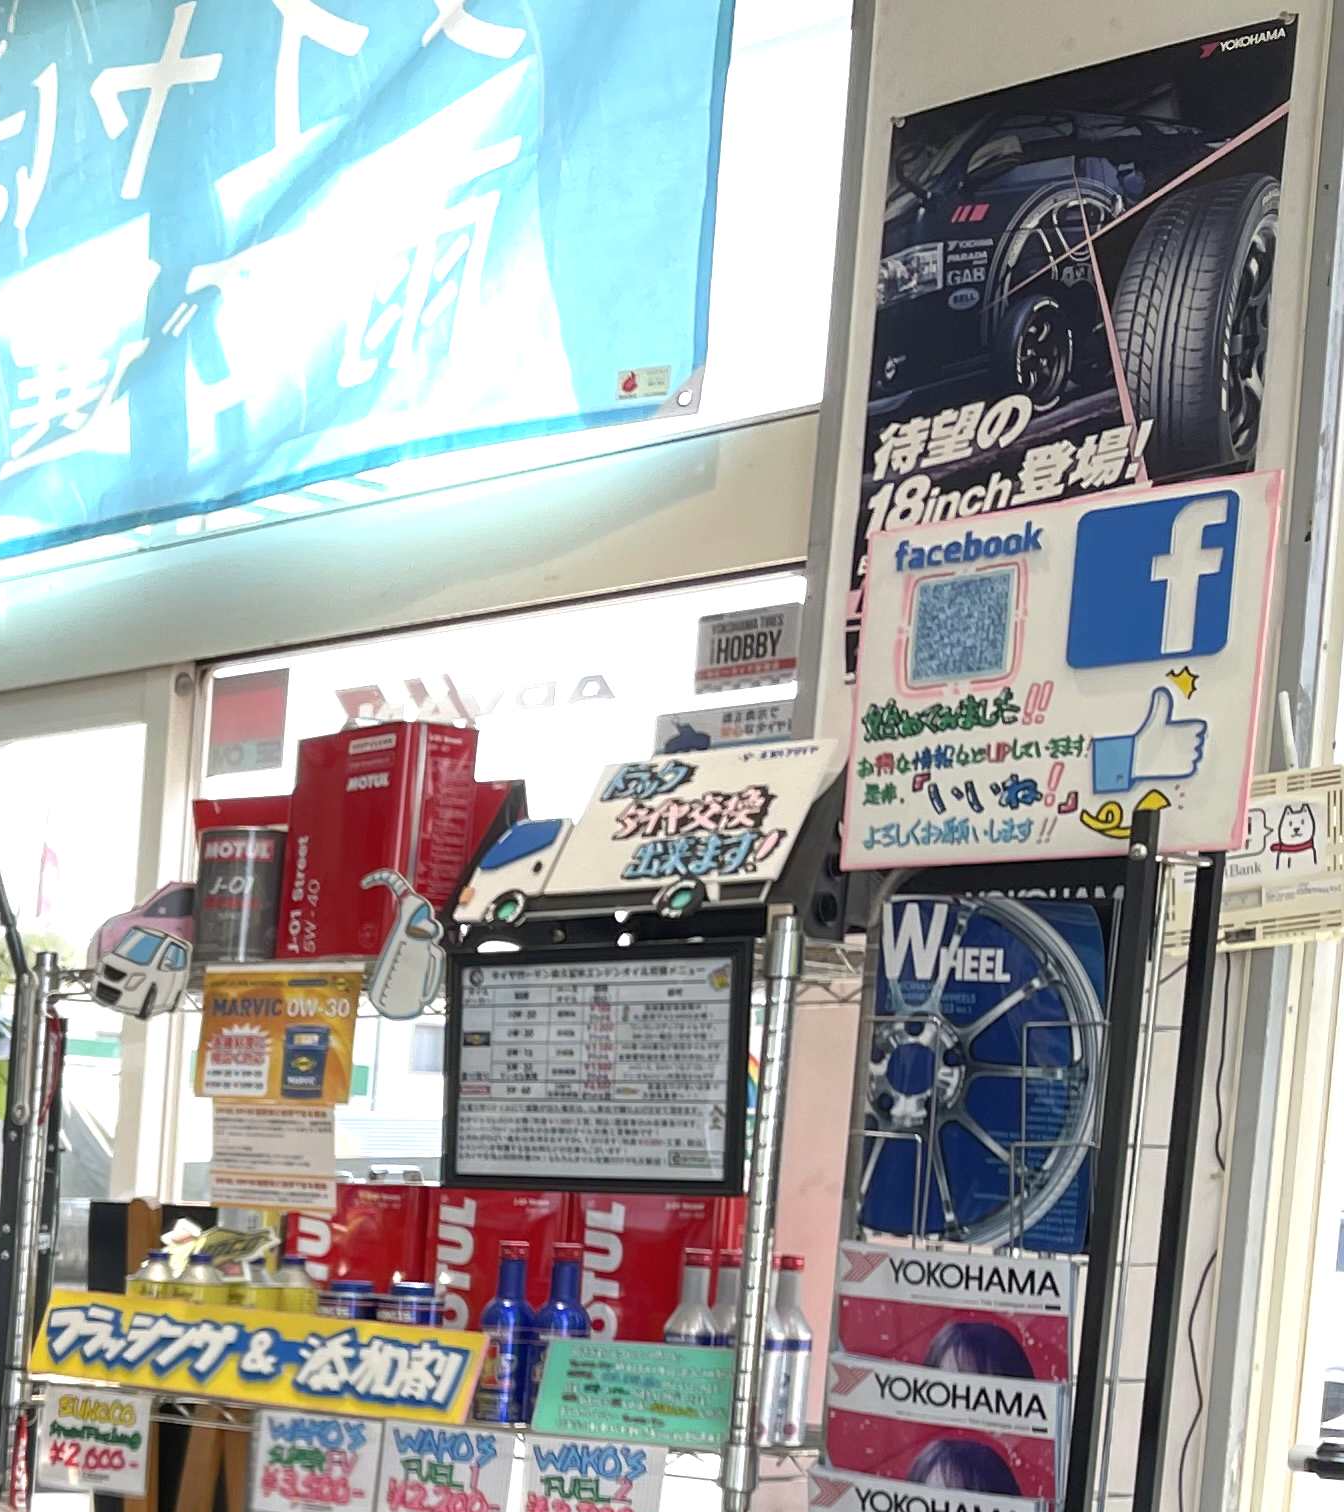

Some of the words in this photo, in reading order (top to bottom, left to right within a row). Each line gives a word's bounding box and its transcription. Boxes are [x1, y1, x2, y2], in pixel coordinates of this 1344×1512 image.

[1220, 28, 1287, 53] YOKOHAMA
[874, 394, 1033, 481] 待望の
[866, 467, 1014, 535] 18inch
[1016, 419, 1154, 497] 登場!
[895, 521, 1044, 572] facebook
[716, 629, 782, 665] HOBBY
[346, 772, 391, 792] MOTUL
[612, 786, 775, 842] タイヤ交換
[621, 830, 786, 880] 出来ます!
[287, 998, 351, 1018] 0W-30
[436, 1196, 477, 1331] OTUL
[583, 1200, 625, 1341] OTUL
[889, 1257, 1061, 1299] YOKOHAMA
[48, 1303, 239, 1378] フラッシング
[238, 1333, 280, 1381] &
[292, 1329, 470, 1409] 添加剤
[874, 1372, 1049, 1422] YOKOHAMA
[393, 1428, 498, 1467] WAKO'S
[532, 1444, 649, 1481] WAKO'S
[402, 1458, 465, 1491] FUEL
[542, 1476, 612, 1503] FUEL
[615, 1476, 632, 1503] 2
